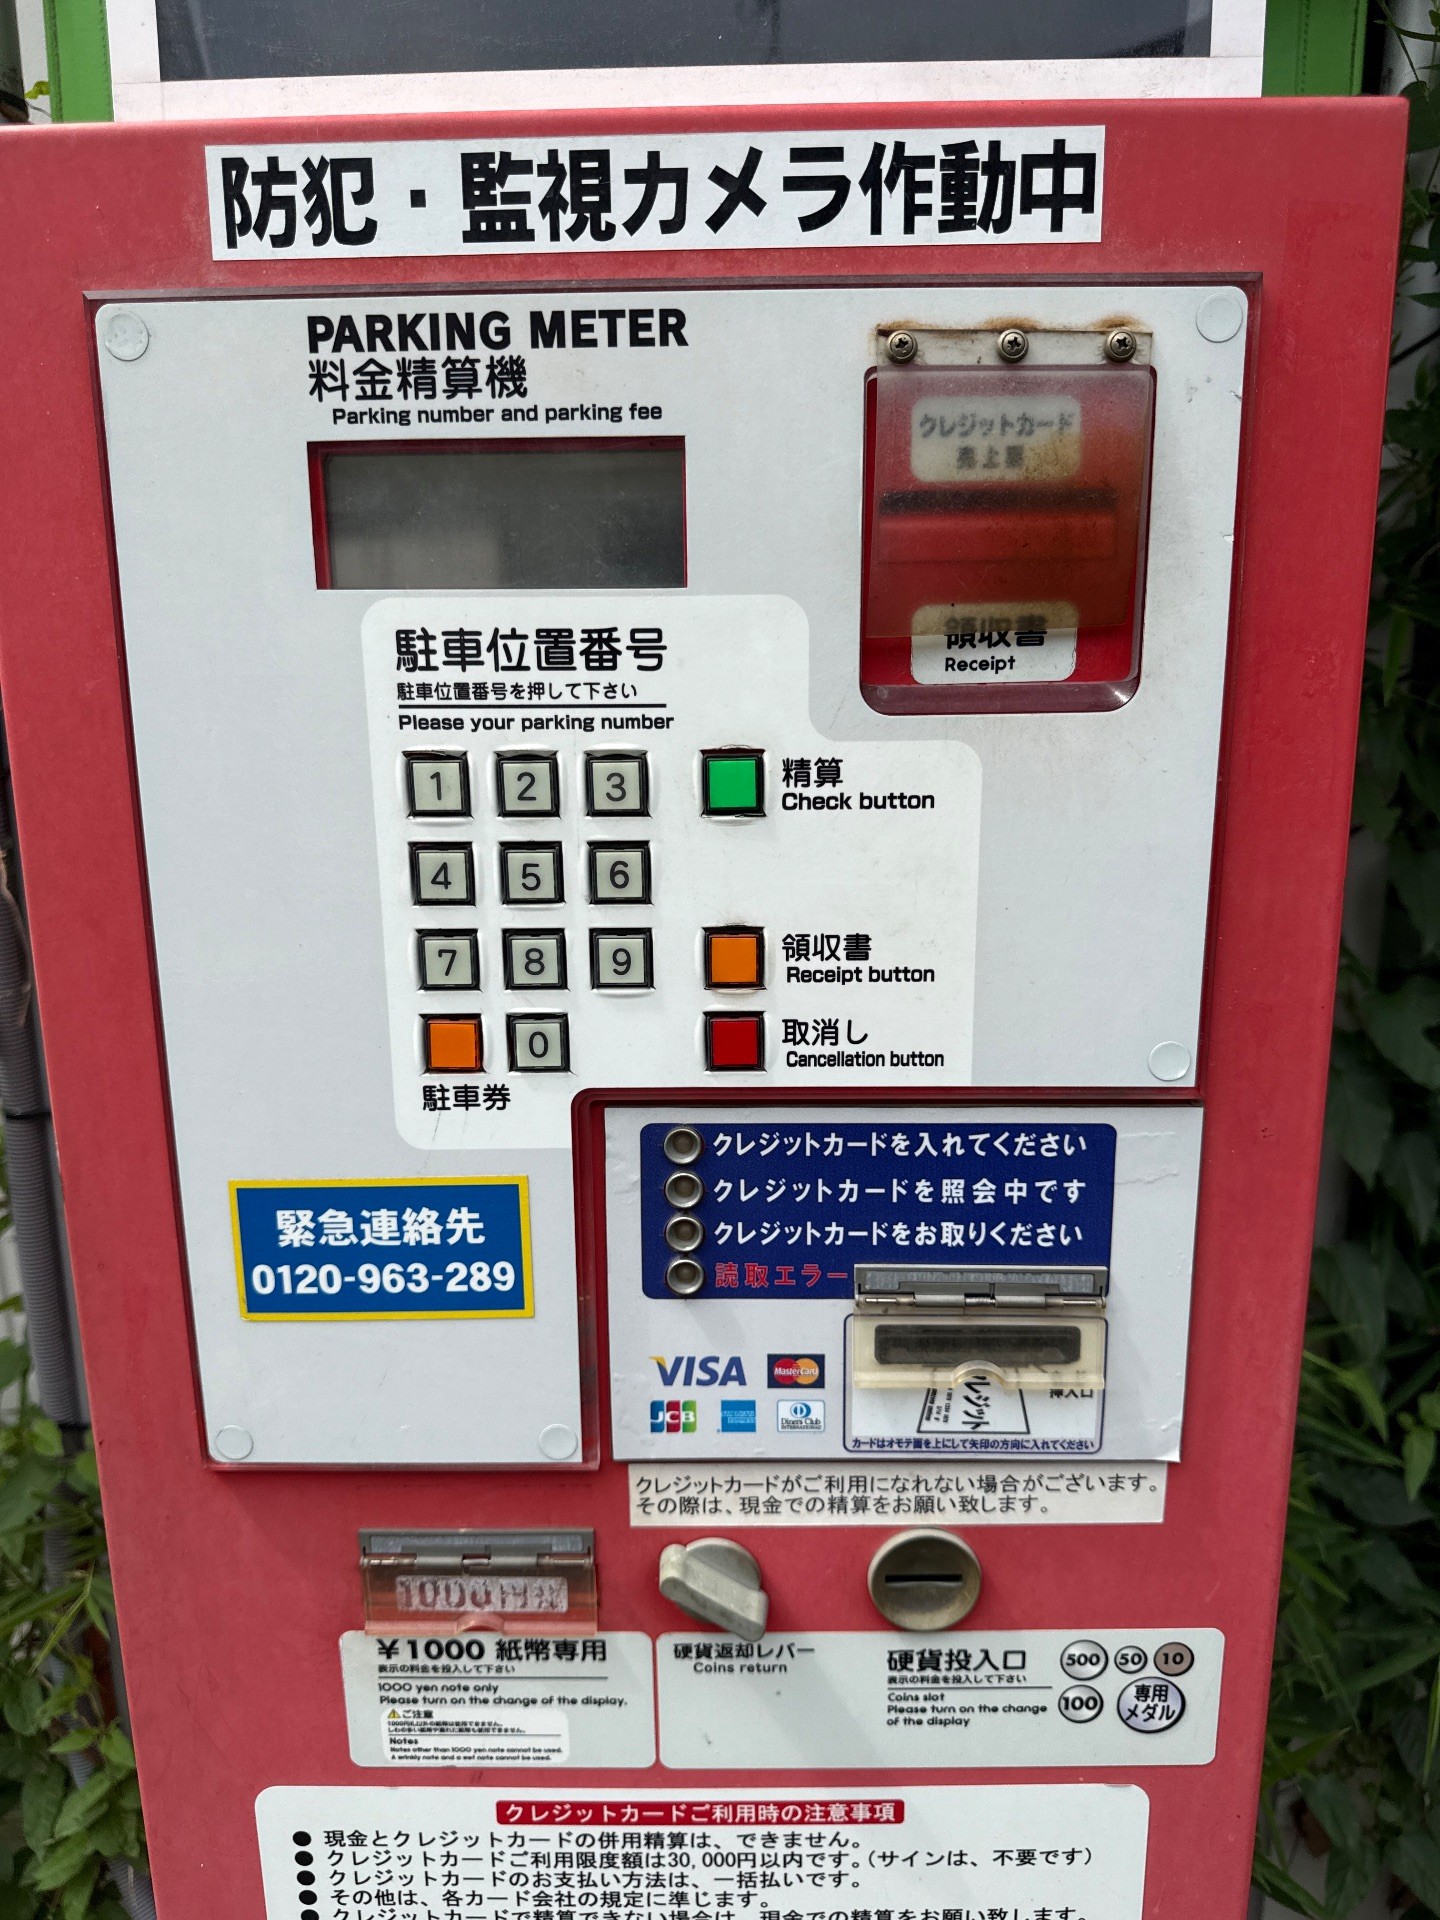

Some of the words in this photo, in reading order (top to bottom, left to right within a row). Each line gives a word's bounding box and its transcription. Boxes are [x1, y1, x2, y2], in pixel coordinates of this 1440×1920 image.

[222, 141, 1097, 250] 防犯・監視カメラ作動中
[307, 311, 512, 356] PARKING
[530, 309, 689, 349] METER
[309, 355, 527, 402] 料金精算機
[333, 408, 411, 426] Parking
[418, 406, 494, 423] number
[502, 405, 538, 421] and
[545, 404, 622, 424] parking
[629, 403, 662, 420] fee
[943, 615, 1050, 650] 領収書
[396, 627, 667, 672] 駐車位置番号
[945, 656, 1015, 674] Receipt
[397, 682, 637, 700] 駐車位置番号を押して下さい
[399, 715, 464, 730] Please
[470, 718, 515, 732] your
[522, 715, 594, 732] parking
[601, 714, 674, 729] number
[782, 757, 843, 788] 精算
[430, 772, 442, 800] 1
[517, 772, 536, 801] 2
[606, 773, 626, 802] 3
[782, 793, 852, 810] Check
[860, 792, 934, 809] button
[431, 862, 452, 889] 4
[522, 863, 541, 891] 5
[610, 861, 629, 889] 6
[782, 933, 872, 962] 領収書
[438, 949, 457, 976] 7
[525, 948, 545, 975] 8
[612, 948, 631, 975] 9
[787, 966, 862, 985] Receipt
[869, 966, 934, 982] button
[782, 1018, 868, 1046] 取消し
[529, 1031, 548, 1058] 0
[787, 1051, 885, 1067] Cancellation
[890, 1051, 944, 1066] button
[423, 1084, 511, 1111] 駐車券
[713, 1132, 1086, 1157] クレジットカードを入れてください
[714, 1178, 1085, 1204] クレジットカードを照会中です
[277, 1207, 485, 1247] 緊急連絡先
[715, 1221, 1082, 1247] クレジットカードをお取りください
[253, 1261, 515, 1294] 0120-963-289
[714, 1262, 849, 1290] 読取エラー
[648, 1355, 747, 1388] VISA
[773, 1365, 819, 1376] MasterCard
[960, 1375, 991, 1430] レジット
[780, 1417, 804, 1425] Diners
[804, 1417, 822, 1425] Club
[635, 1472, 1158, 1495] クレジットカードがご利用になれない場合がございます。
[636, 1494, 1050, 1516] その際は、現金での精算をお願い致します。
[376, 1638, 486, 1660] ¥1000
[494, 1638, 608, 1663] 紙幣専用
[672, 1643, 815, 1661] 硬貨返却レバー
[887, 1649, 1026, 1672] 硬貨投入口
[1066, 1653, 1100, 1666] 500
[1119, 1653, 1142, 1665] 50
[1161, 1652, 1184, 1665] 10
[377, 1664, 516, 1674] 表示の料金を投入して下さい
[694, 1662, 734, 1673] Coins
[740, 1663, 787, 1673] return
[377, 1682, 412, 1693] 1000
[415, 1684, 437, 1695] yen
[440, 1682, 470, 1692] note
[473, 1682, 499, 1695] only
[886, 1674, 1027, 1685] 表示の料金を投入して下さい
[379, 1695, 419, 1706] Please
[422, 1695, 447, 1705] turn
[450, 1697, 465, 1705] on
[468, 1695, 491, 1705] the
[492, 1695, 538, 1708] change
[540, 1695, 555, 1706] of
[557, 1695, 579, 1706] the
[887, 1693, 920, 1703] Coins
[922, 1693, 945, 1702] slot
[1063, 1696, 1098, 1711] 100
[1134, 1684, 1169, 1703] 専用
[887, 1704, 927, 1715] Please
[930, 1704, 957, 1714] turn
[958, 1705, 975, 1714] on
[977, 1704, 999, 1714] the
[1001, 1704, 1048, 1716] change
[1126, 1703, 1177, 1723] メダル
[887, 1716, 900, 1726] of
[903, 1716, 924, 1726] the
[926, 1716, 971, 1728] display
[506, 1803, 896, 1824] クレジットカードご利用時の注意事項
[323, 1829, 862, 1848] 現金とクレジットカードの併用精算は、できません。
[329, 1869, 861, 1890] クレジットカードのお支払い方法は、一括払いです。
[330, 1888, 769, 1908] その他は、各カード会社の規定に準じます。
